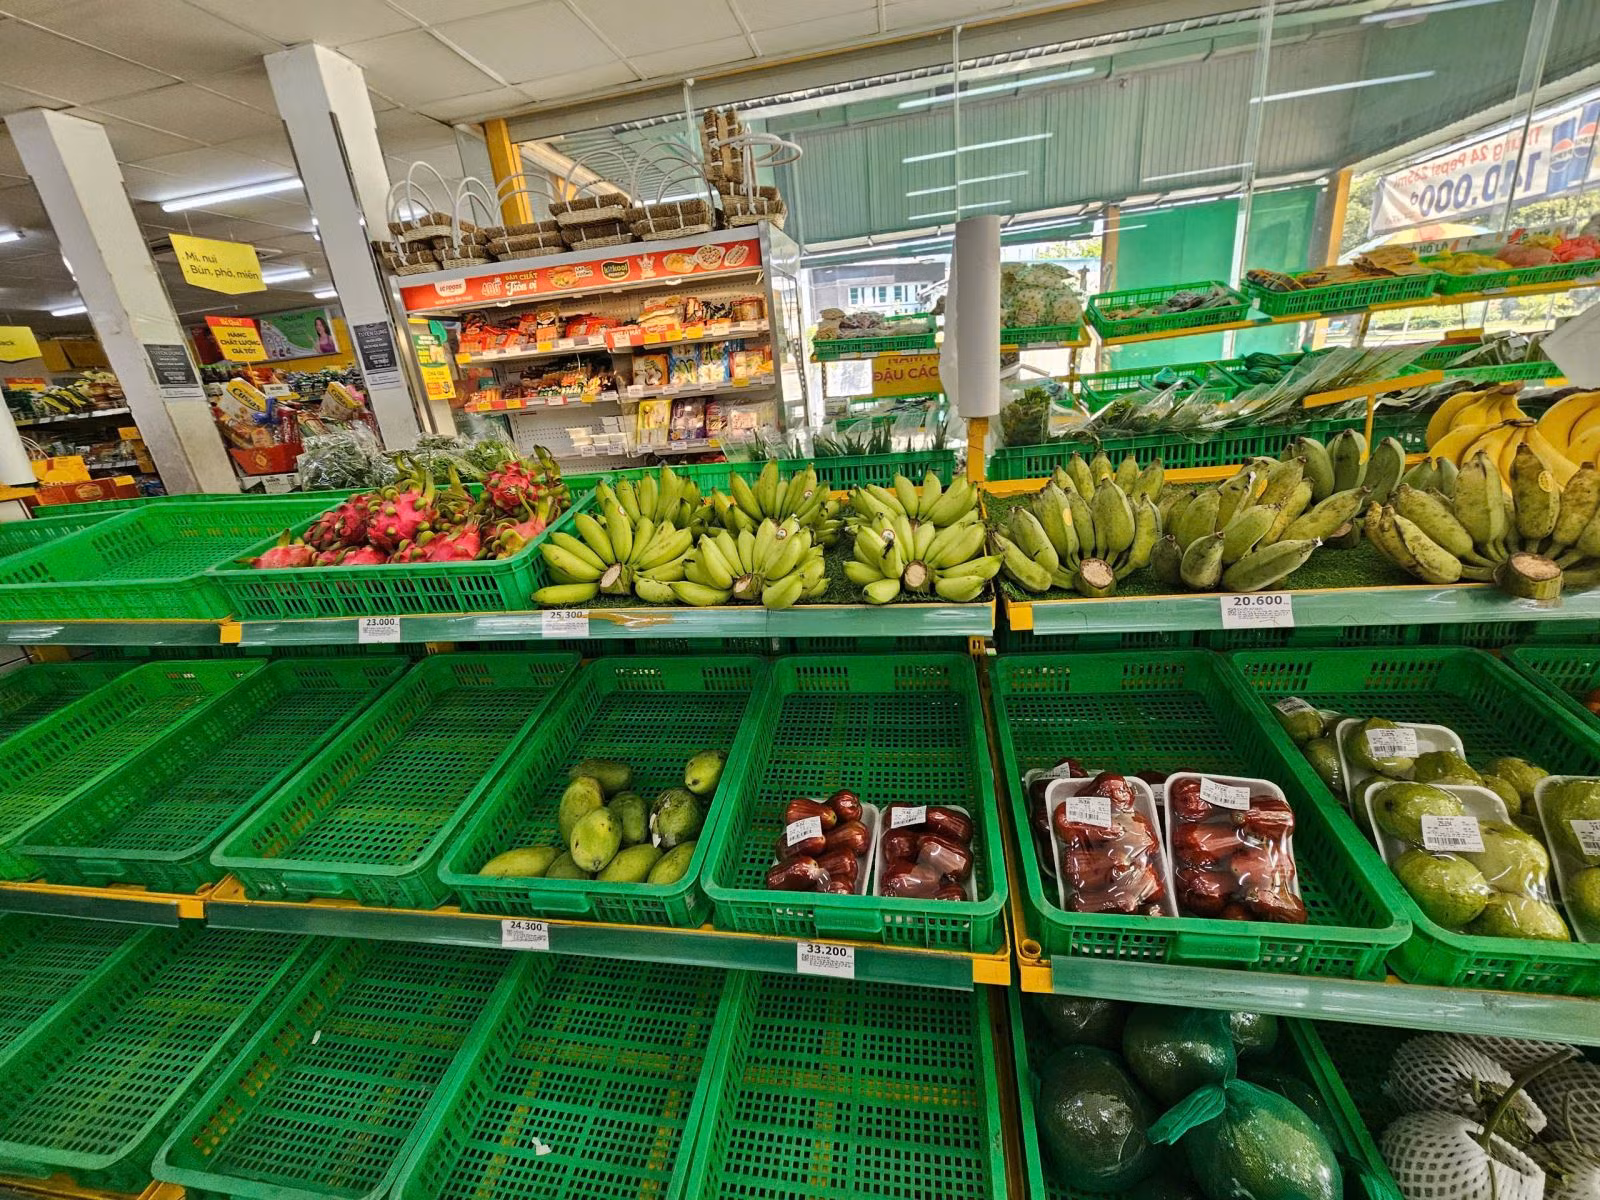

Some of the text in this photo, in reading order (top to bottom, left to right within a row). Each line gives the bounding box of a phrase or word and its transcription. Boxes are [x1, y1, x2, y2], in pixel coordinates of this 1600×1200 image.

[873, 368, 904, 384] ĐẬU
[1233, 595, 1283, 606] 20.600
[366, 618, 395, 626] 23.000
[510, 920, 543, 931] 24.300
[806, 944, 847, 957] 33.200
